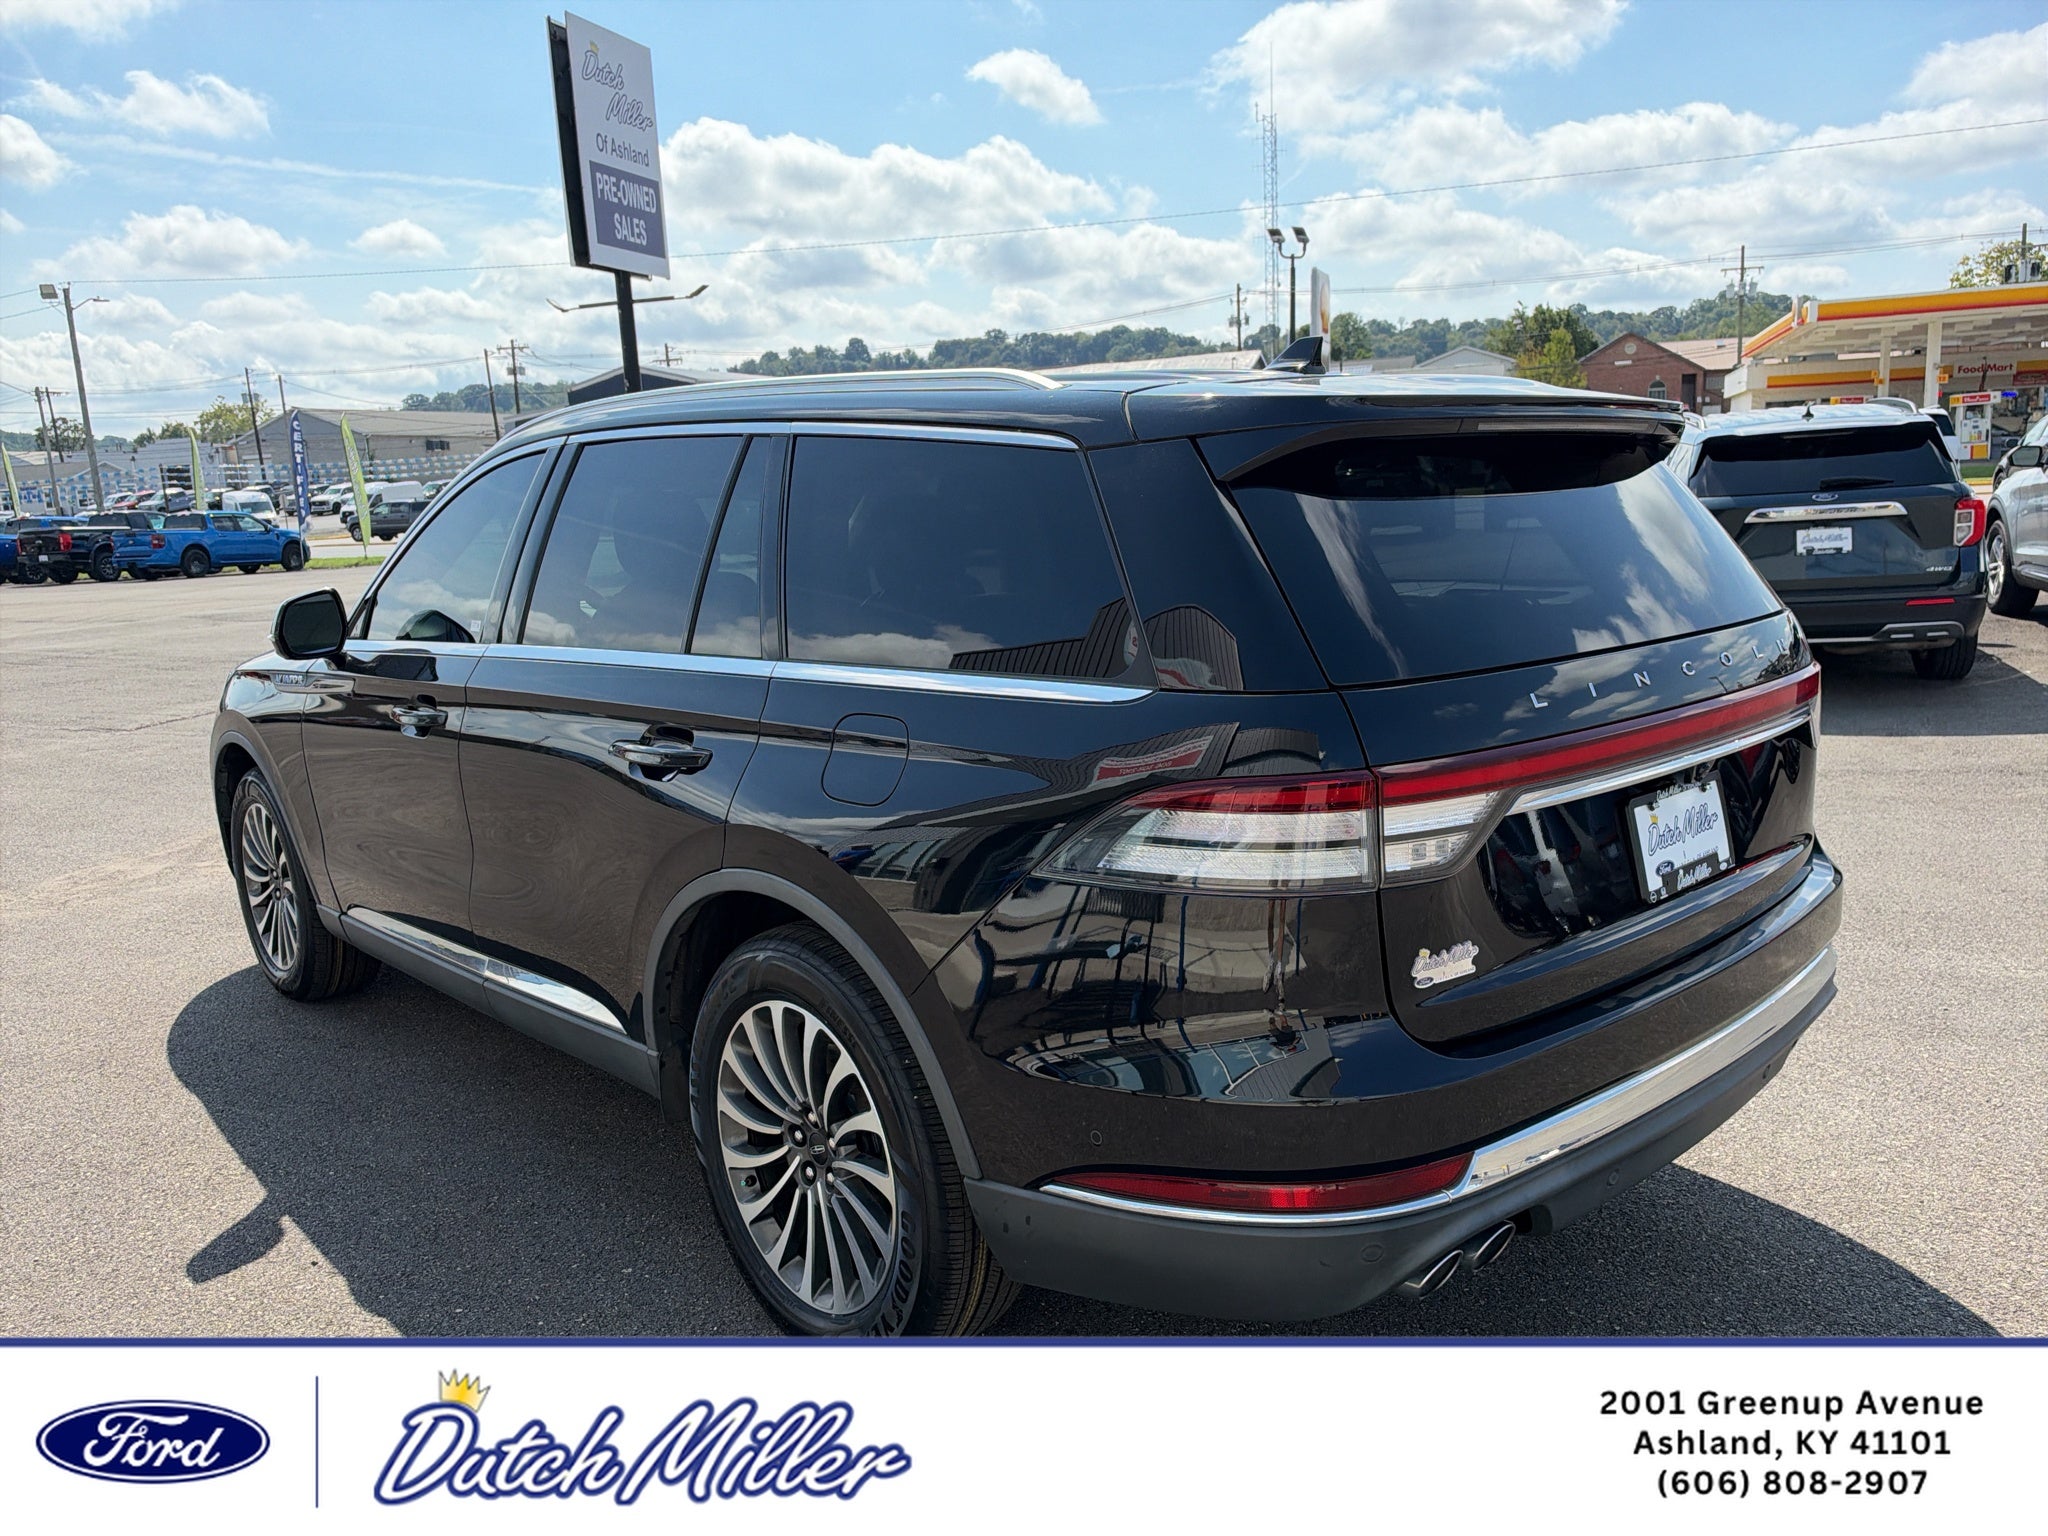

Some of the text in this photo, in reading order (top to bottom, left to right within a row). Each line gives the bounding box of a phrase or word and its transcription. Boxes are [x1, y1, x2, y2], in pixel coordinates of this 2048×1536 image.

[582, 50, 624, 91] Dutch
[606, 91, 653, 131] Miller
[596, 133, 650, 167] Of Ashland
[596, 172, 657, 213] PRE-OWNED
[614, 212, 648, 246] SALES
[1958, 363, 2014, 374] Food Mart
[1529, 638, 1790, 709] LINCOLN
[1648, 802, 1718, 857] Dutch Miller
[1412, 950, 1449, 975] Dutch
